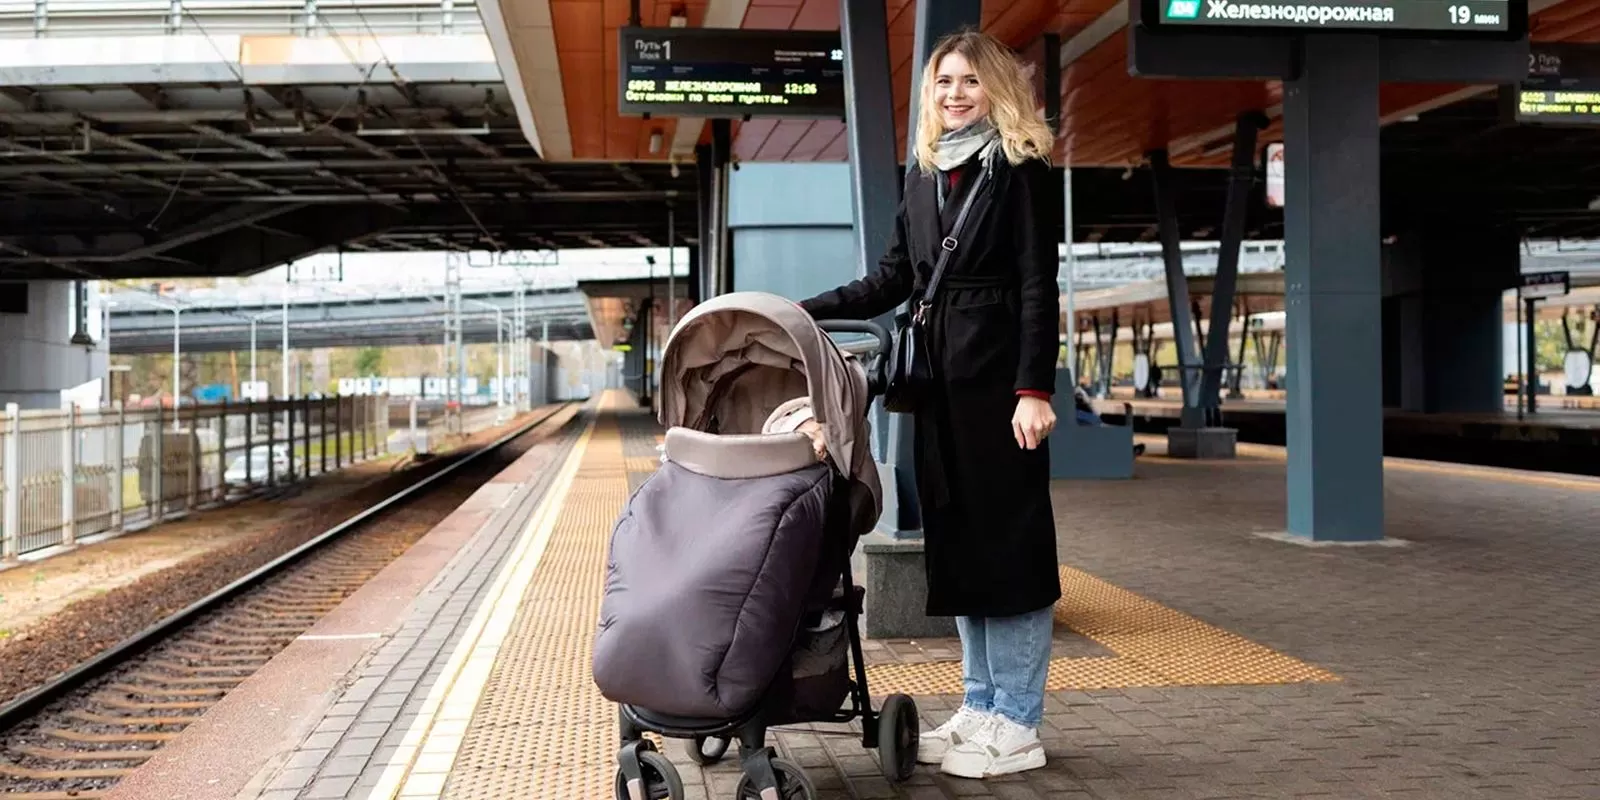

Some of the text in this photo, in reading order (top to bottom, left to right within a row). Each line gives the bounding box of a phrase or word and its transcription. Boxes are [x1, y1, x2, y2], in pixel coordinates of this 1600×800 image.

[1207, 0, 1395, 24] Железнодорожная
[1448, 5, 1471, 24] 19
[1474, 14, 1500, 25] мин
[635, 39, 671, 60] Путь 1
[784, 83, 817, 94] 12:26
[625, 90, 685, 102] Остановки
[688, 93, 704, 102] по
[707, 93, 734, 103] всем
[1574, 104, 1588, 113] по
